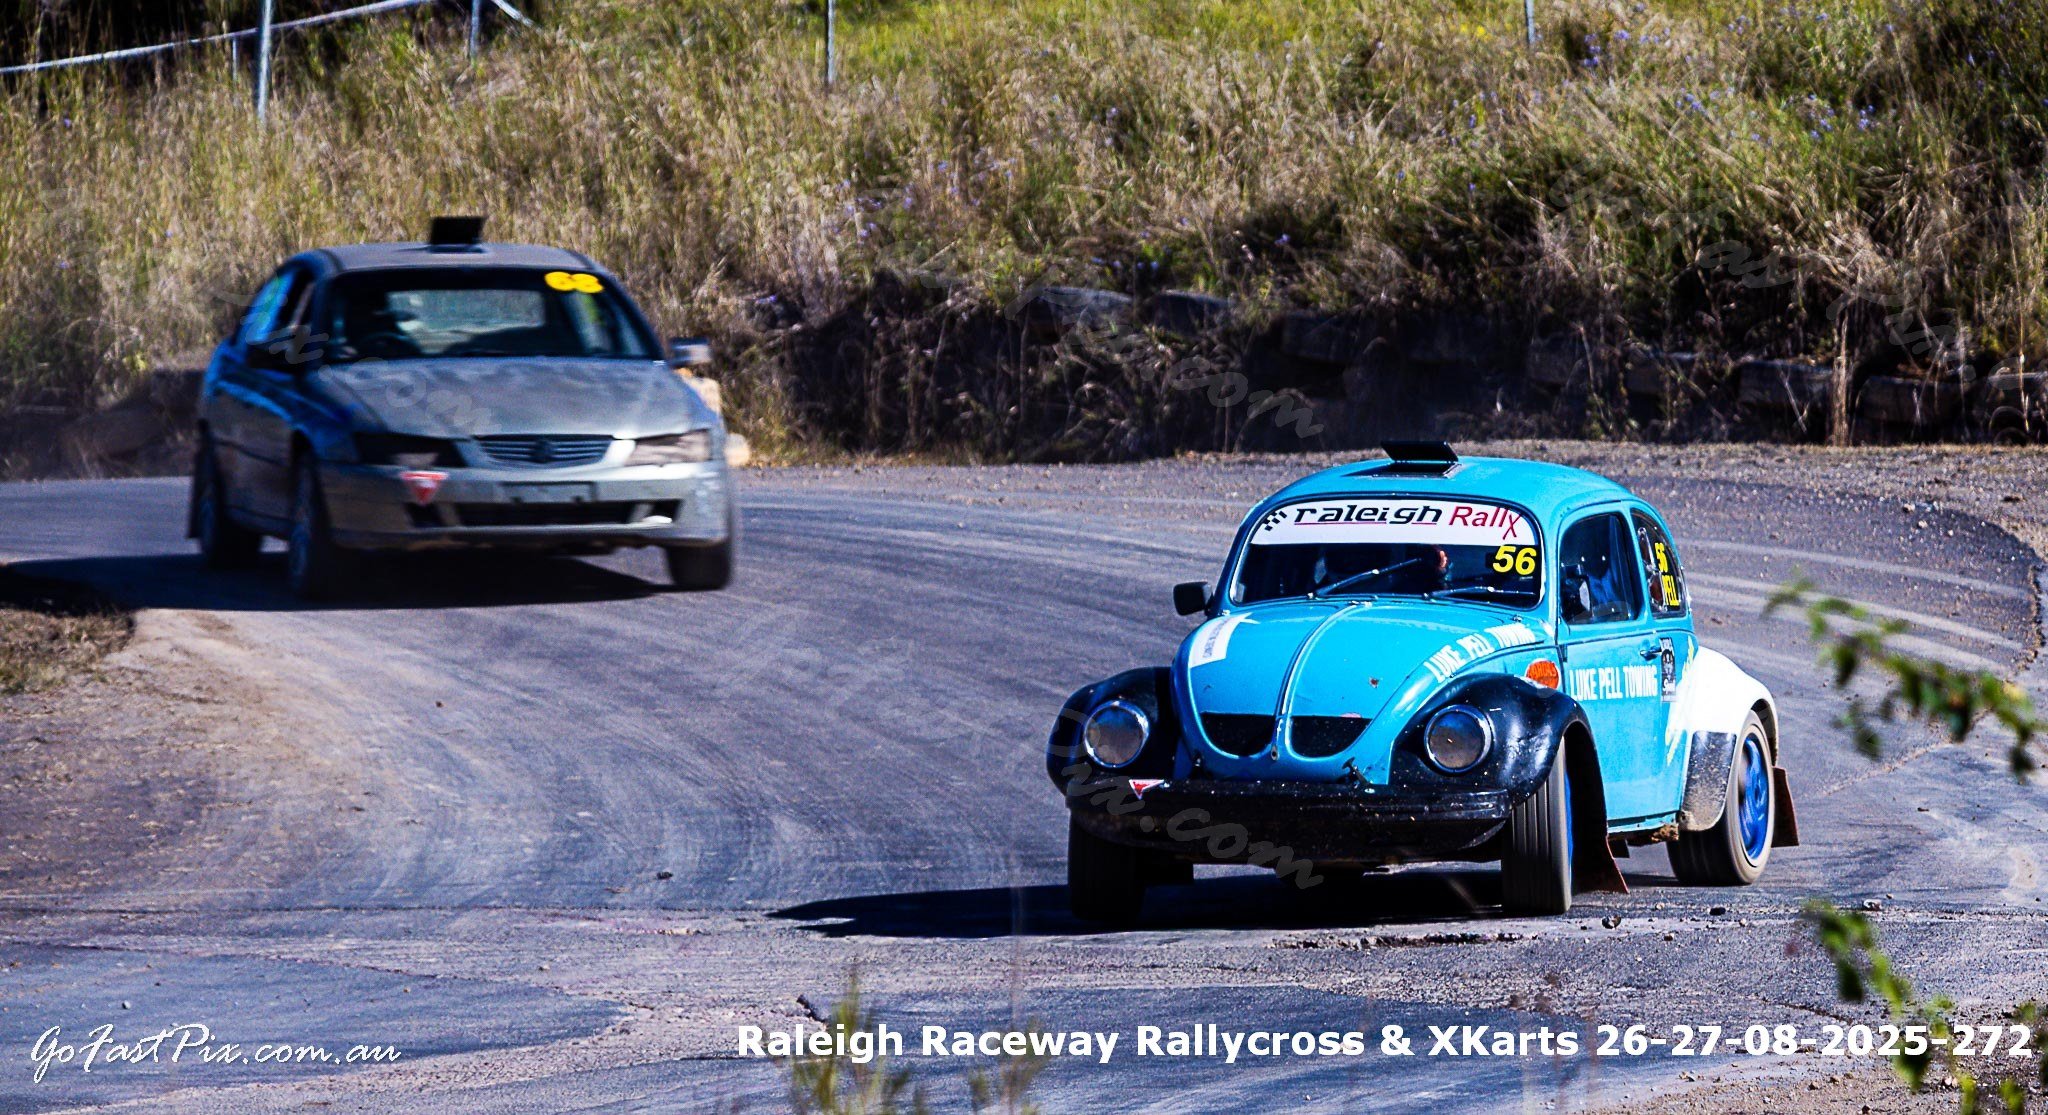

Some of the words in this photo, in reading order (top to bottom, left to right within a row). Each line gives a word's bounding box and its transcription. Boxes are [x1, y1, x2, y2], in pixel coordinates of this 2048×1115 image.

[1294, 504, 1443, 525] raleigh
[1492, 545, 1538, 576] 56
[1661, 574, 1680, 606] PELL
[1423, 644, 1467, 683] LUKE
[1456, 632, 1496, 661] PELL
[1569, 667, 1598, 702] LUKE
[1598, 666, 1623, 700] PELL
[1622, 664, 1659, 699] TOWING
